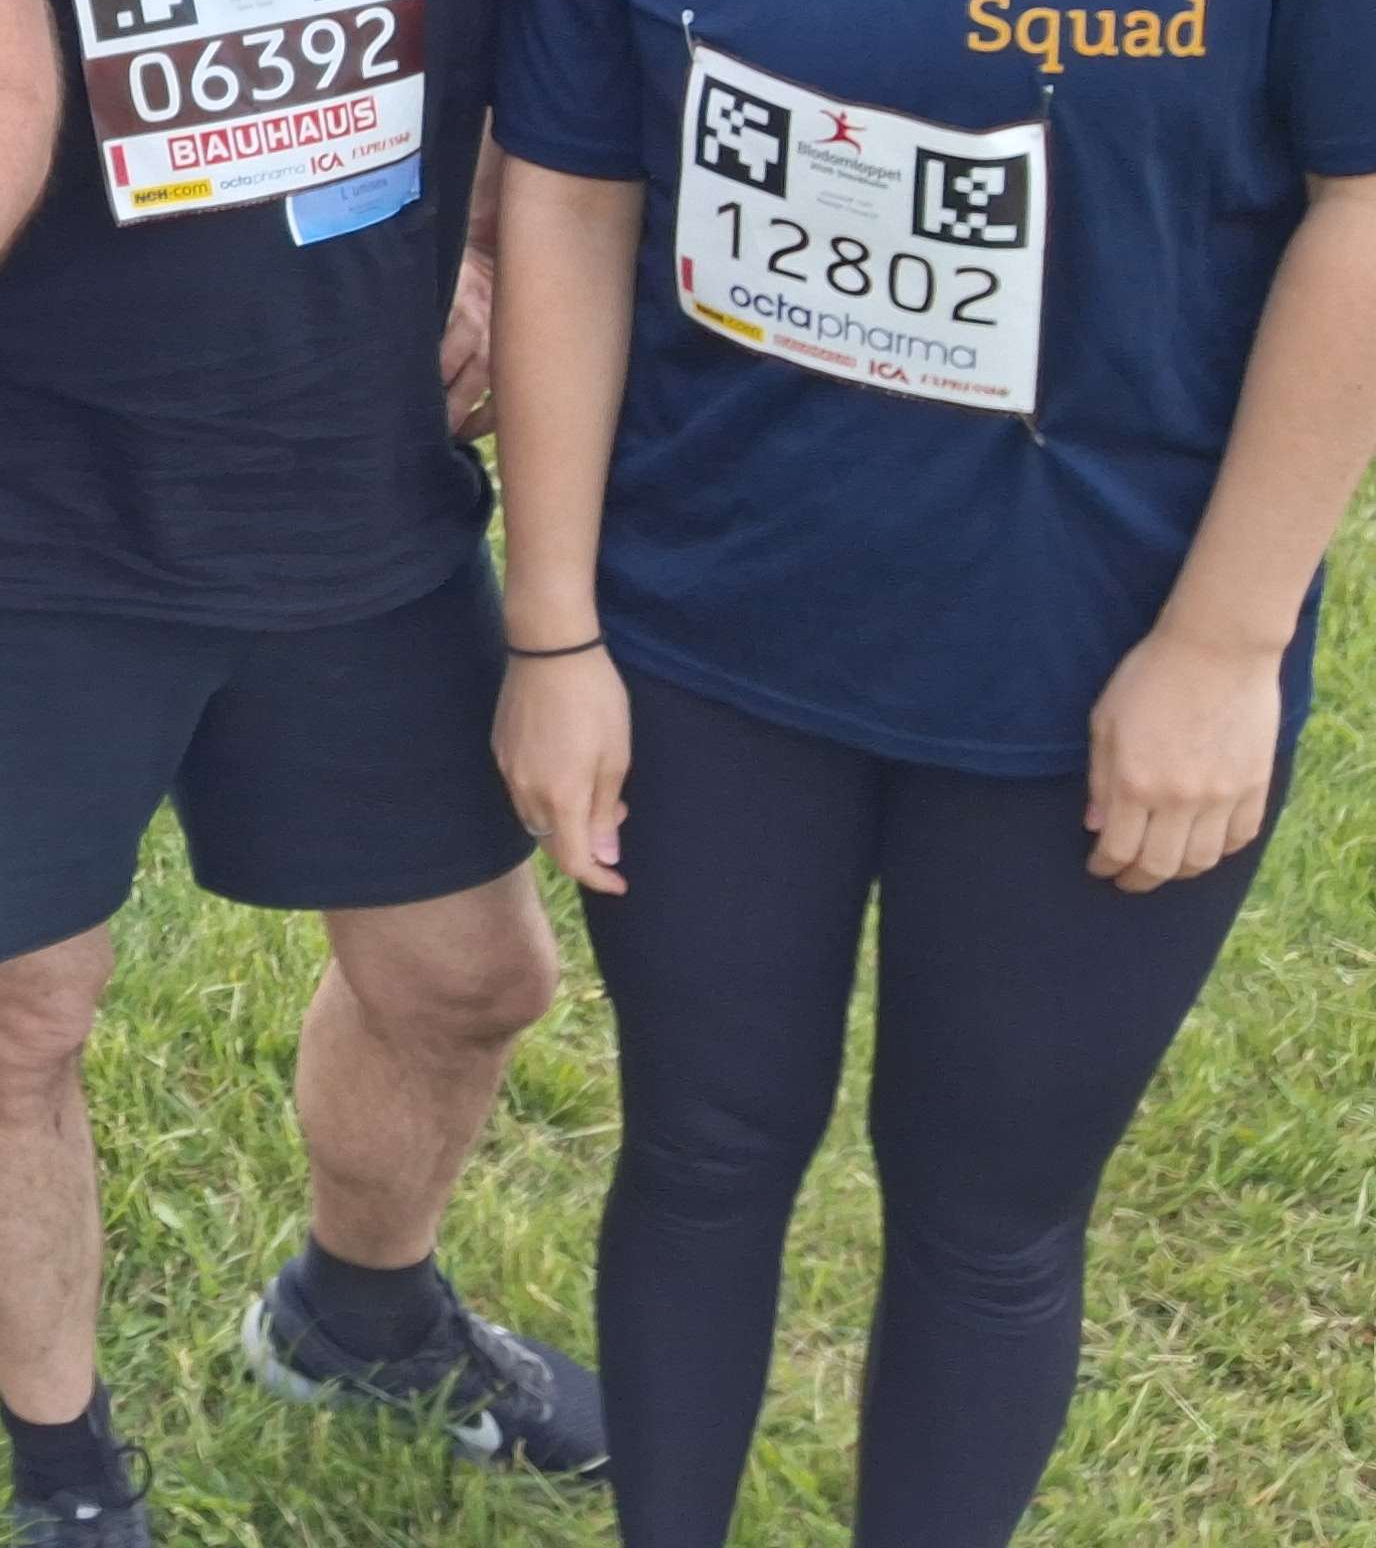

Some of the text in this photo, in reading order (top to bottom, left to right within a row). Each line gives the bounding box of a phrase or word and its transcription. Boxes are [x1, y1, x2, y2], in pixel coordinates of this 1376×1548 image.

[129, 7, 399, 123] 06392
[171, 97, 375, 170] BAUHAUS
[310, 152, 344, 175] ICA
[717, 201, 1001, 326] 12802
[729, 282, 978, 370] octapharma
[868, 358, 910, 385] ICA
